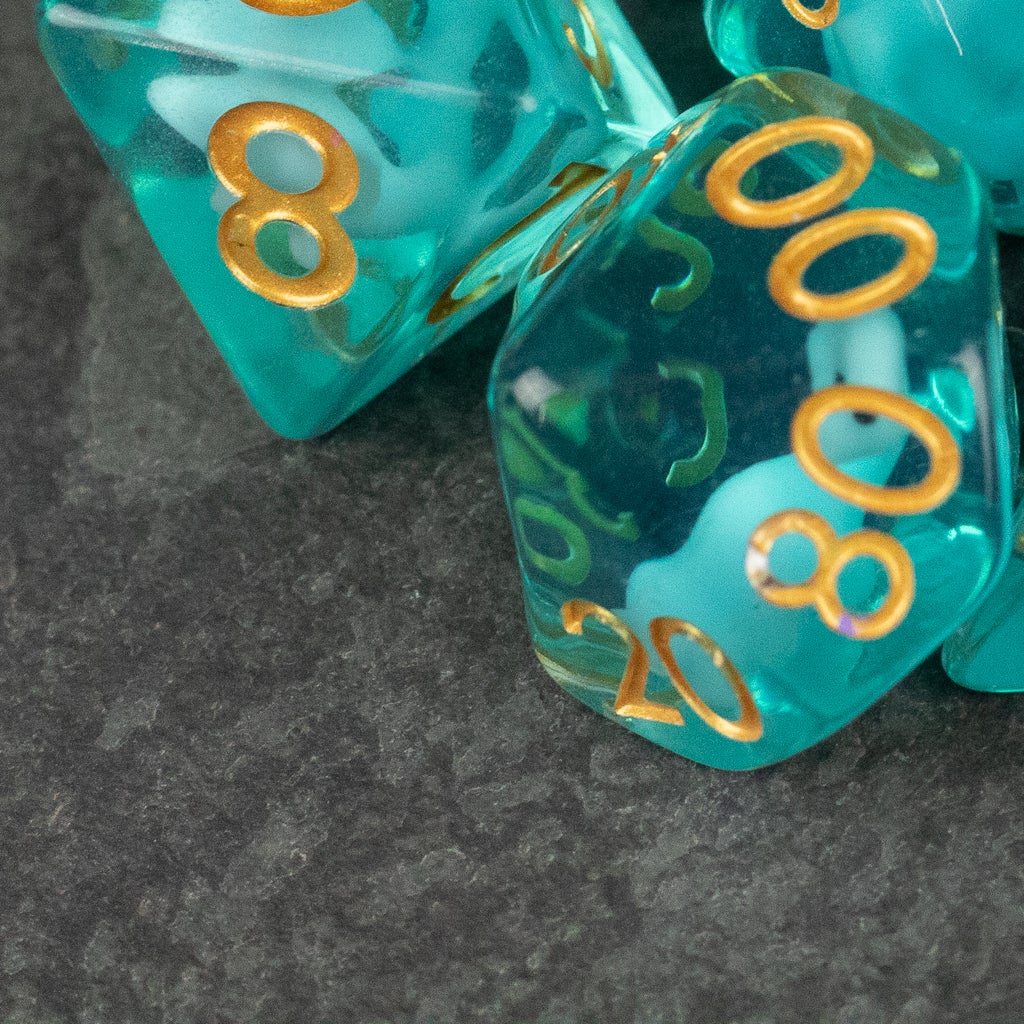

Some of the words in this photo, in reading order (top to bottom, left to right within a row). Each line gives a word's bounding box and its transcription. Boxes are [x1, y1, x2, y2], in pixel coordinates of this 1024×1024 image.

[208, 100, 361, 309] 8
[705, 116, 938, 320] 00
[745, 384, 962, 641] 80
[561, 600, 763, 742] 20
